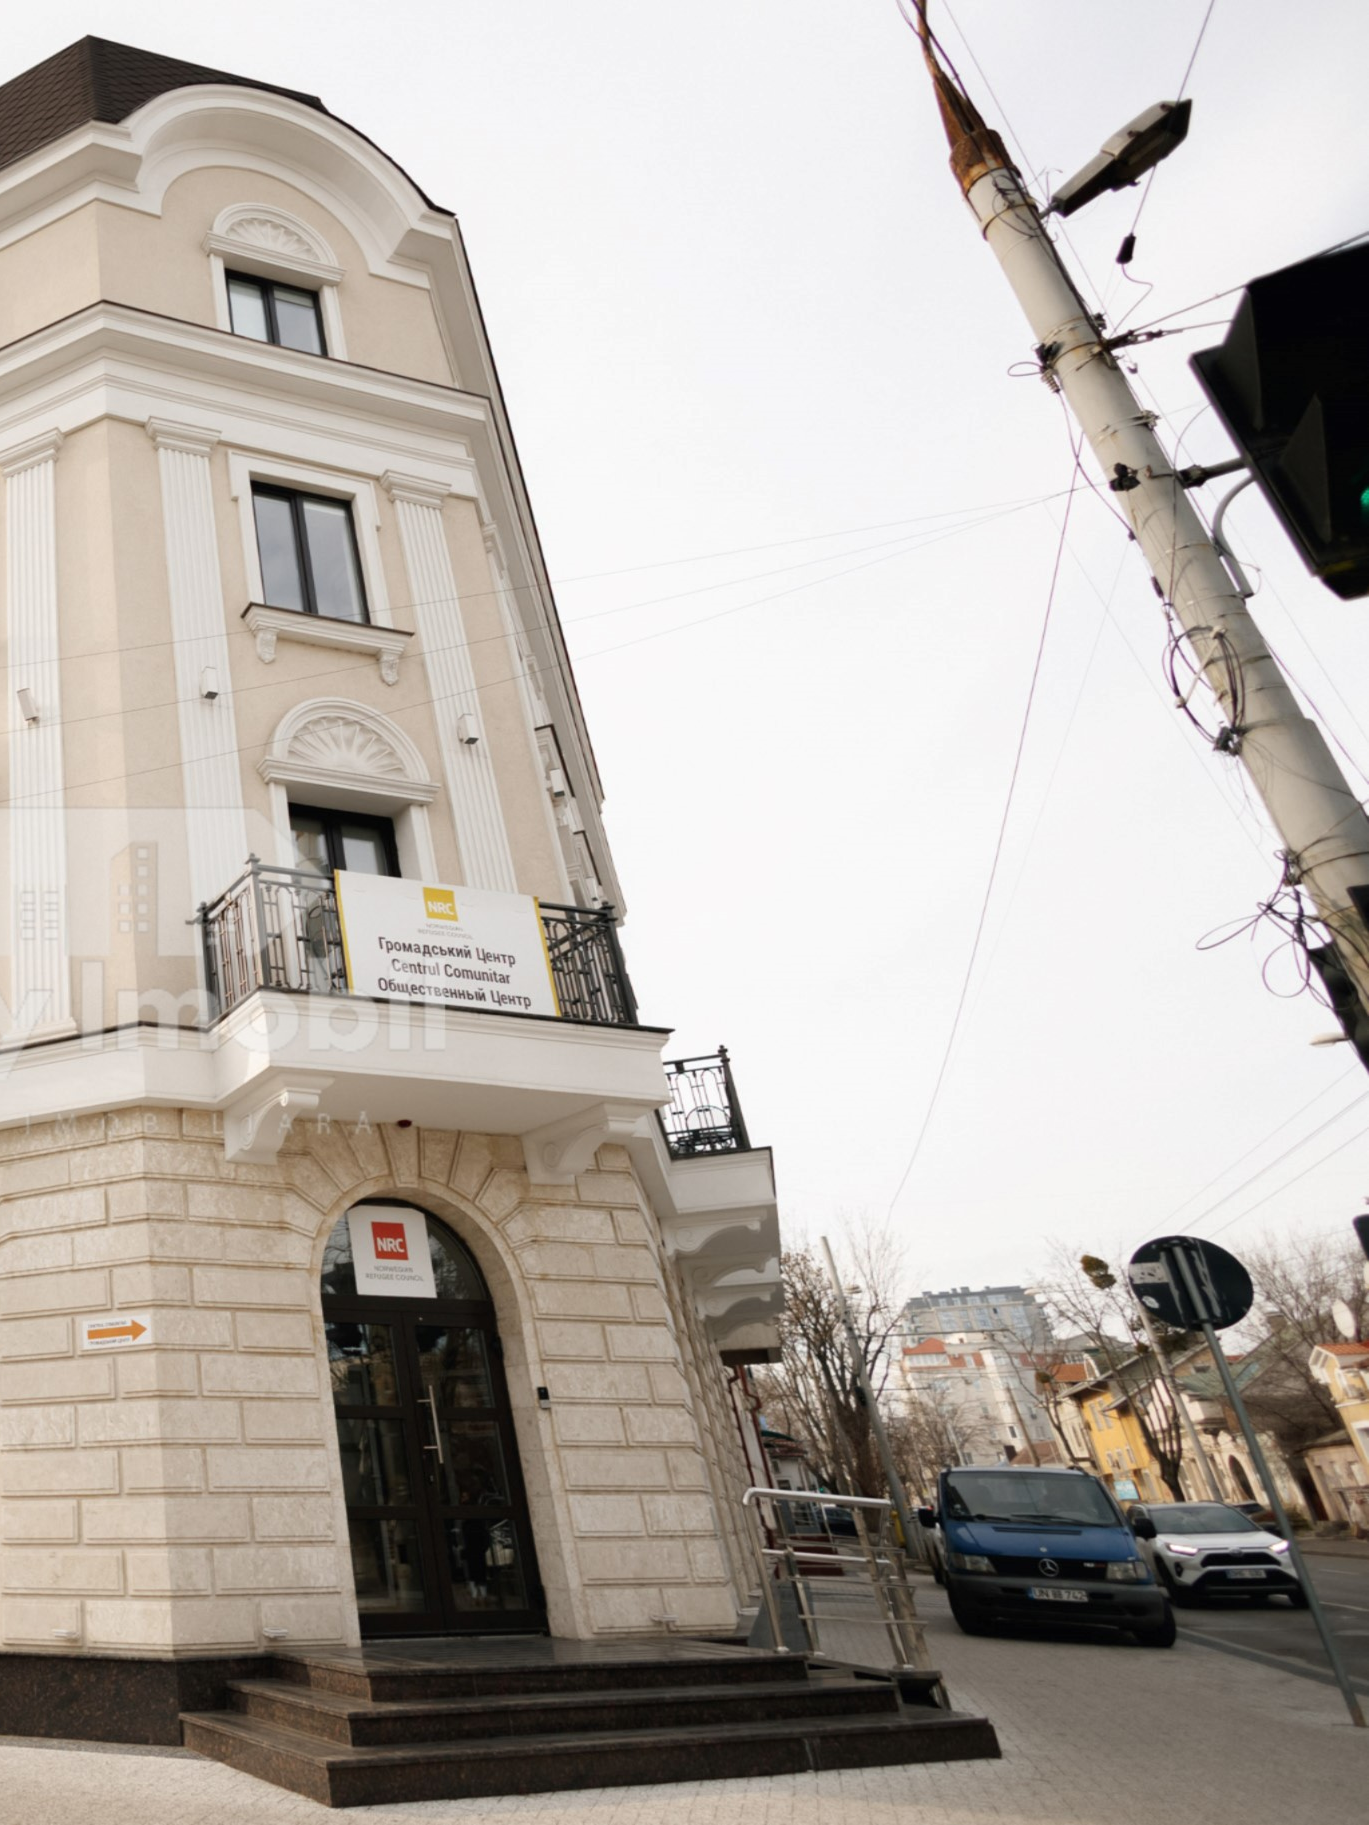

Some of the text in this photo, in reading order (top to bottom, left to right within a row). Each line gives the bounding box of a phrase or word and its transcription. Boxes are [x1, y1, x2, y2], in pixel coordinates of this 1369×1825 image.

[427, 901, 455, 916] NRC
[377, 936, 516, 968] Громадський Центр
[391, 958, 511, 985] Centrul Comunitar
[377, 977, 532, 1010] Общественный Центр
[376, 1237, 405, 1253] NRC
[374, 1265, 413, 1273] NORWEGIAN
[395, 1274, 424, 1282] COUNCIL
